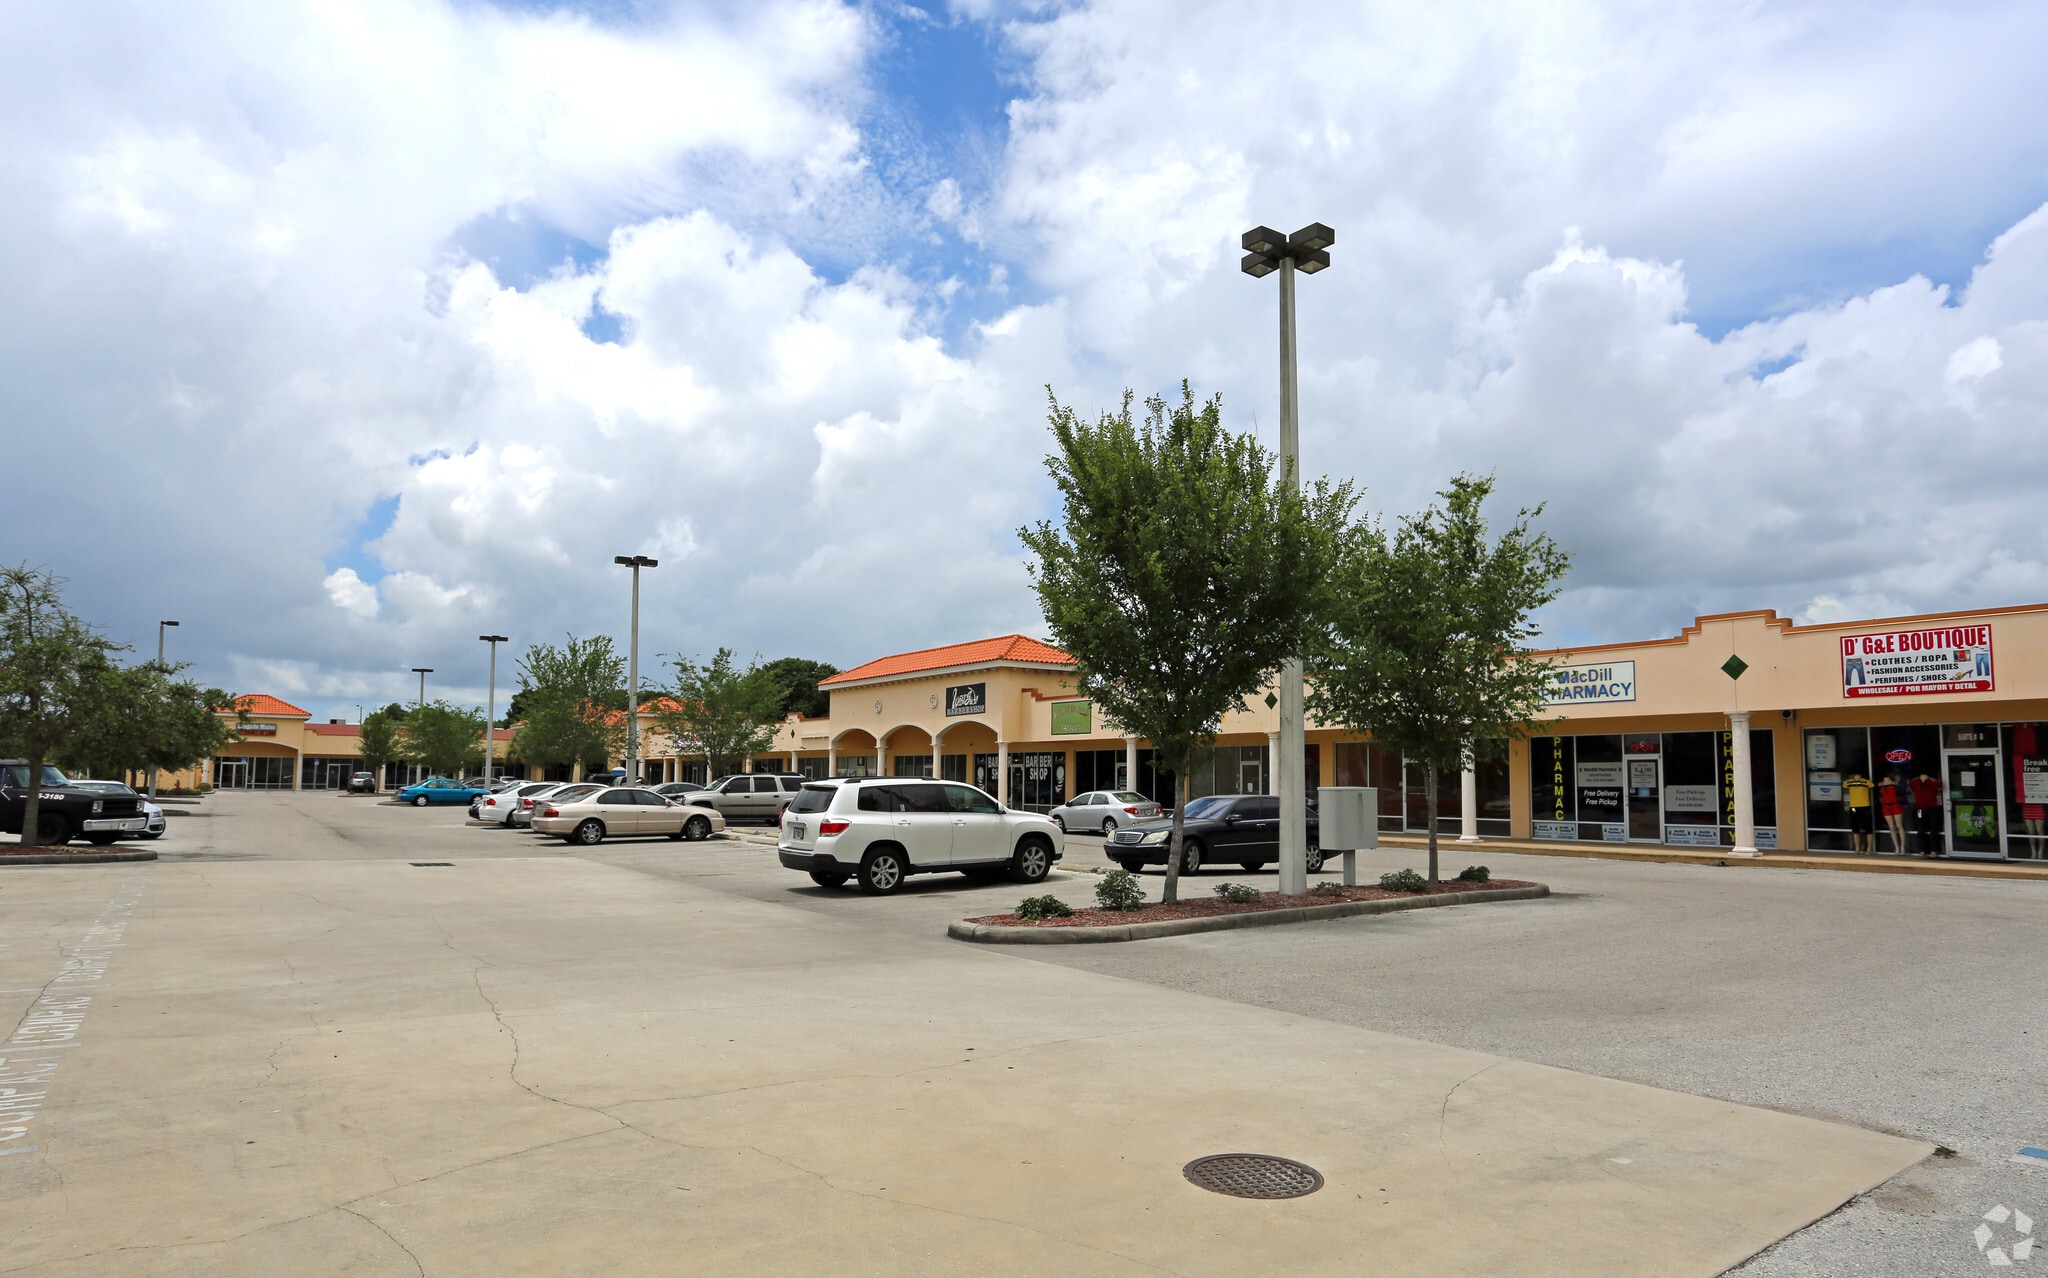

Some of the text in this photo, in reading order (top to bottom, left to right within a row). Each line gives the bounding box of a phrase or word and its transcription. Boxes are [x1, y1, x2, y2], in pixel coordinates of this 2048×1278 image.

[1844, 628, 1987, 656] D' G&E BOUTIQUE
[1871, 656, 1912, 666] CLOTHES
[1922, 654, 1948, 662] ROPA
[1872, 663, 1959, 675] FASHION ACCESSORIES
[1558, 668, 1612, 684] MacDill
[1875, 675, 1914, 684] PERFUMES
[1921, 674, 1947, 682] SHOES
[1541, 682, 1632, 700] PHARMACY
[1858, 686, 1898, 694] WHOLESALE
[1922, 684, 1946, 692] MAYOR
[1954, 682, 1977, 690] DETAL
[988, 756, 1012, 768] BARR
[1885, 752, 1912, 760] OPEN
[1598, 798, 1618, 806] Pickup
[11, 994, 92, 1044] COMPACT
